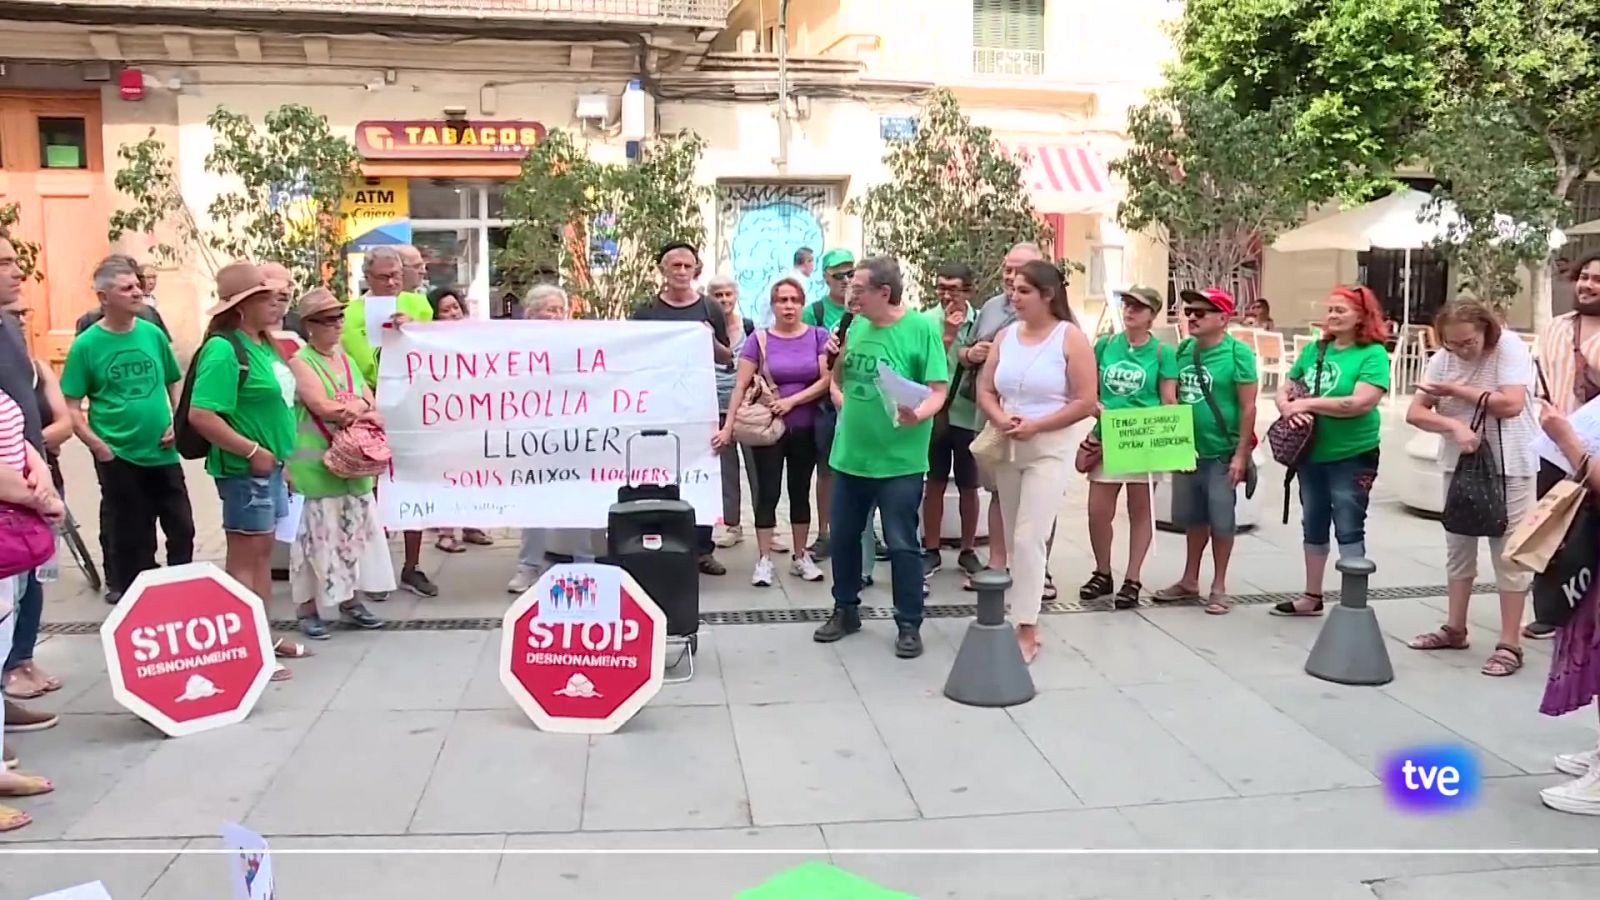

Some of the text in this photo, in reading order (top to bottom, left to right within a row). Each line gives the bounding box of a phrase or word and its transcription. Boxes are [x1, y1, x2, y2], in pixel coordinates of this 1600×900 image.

[405, 127, 536, 146] TABACOS
[354, 190, 394, 204] ATM
[353, 207, 396, 220] Cajero
[110, 360, 153, 380] STOP
[406, 347, 606, 384] PUNXEM LA
[1107, 366, 1143, 382] STOP
[422, 389, 650, 426] BOMBOLLA DE
[483, 426, 622, 459] LLOGUER
[443, 468, 503, 488] SOUS
[510, 467, 581, 486] BAIXOS
[399, 501, 435, 520] PAH
[130, 612, 242, 662] STOP
[527, 616, 640, 652] STOP
[136, 646, 248, 679] DESNONAMENTS
[526, 652, 638, 669] DESNONAMENTS
